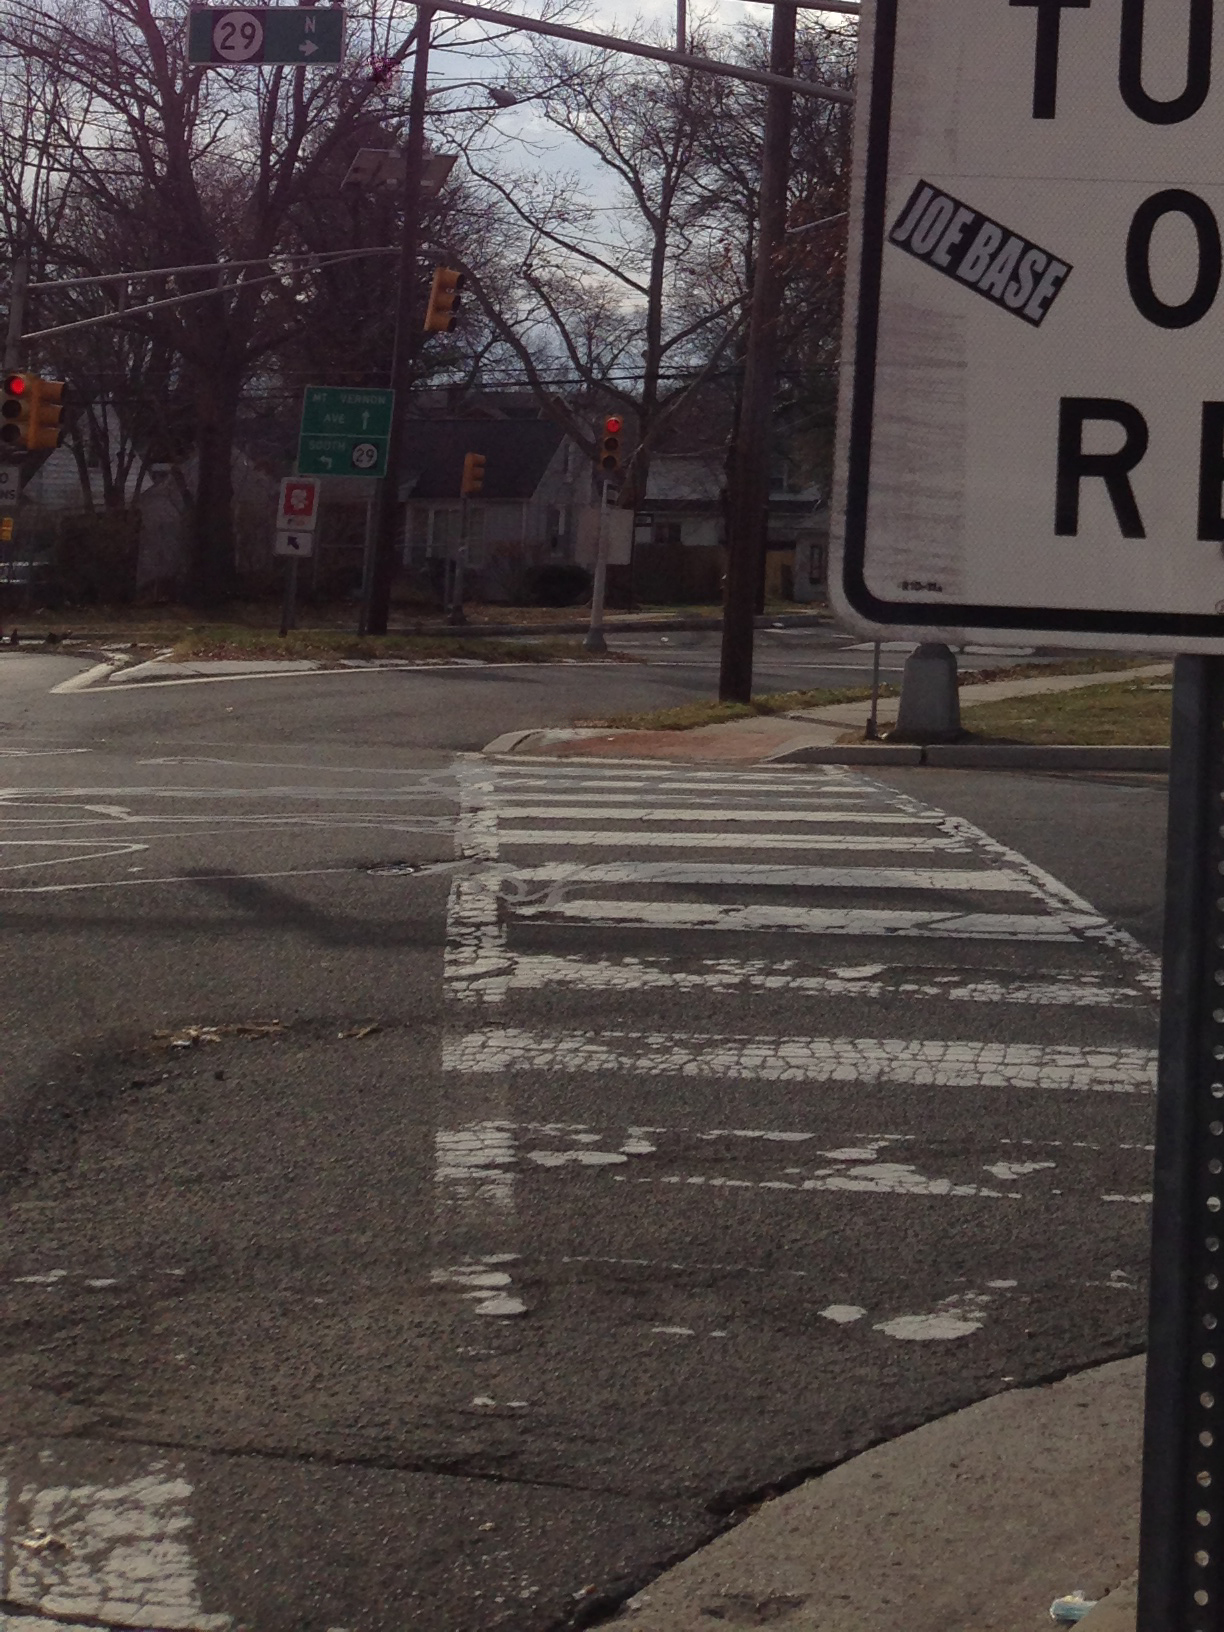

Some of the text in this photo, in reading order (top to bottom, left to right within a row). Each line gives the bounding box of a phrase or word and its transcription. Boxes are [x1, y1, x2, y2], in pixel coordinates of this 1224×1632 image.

[304, 16, 316, 34] N
[218, 21, 257, 51] 29
[893, 187, 1069, 321] JOE BASE
[340, 393, 386, 405] VERNON
[322, 412, 345, 424] AVE
[308, 439, 346, 451] SOUTH
[355, 447, 375, 463] 29
